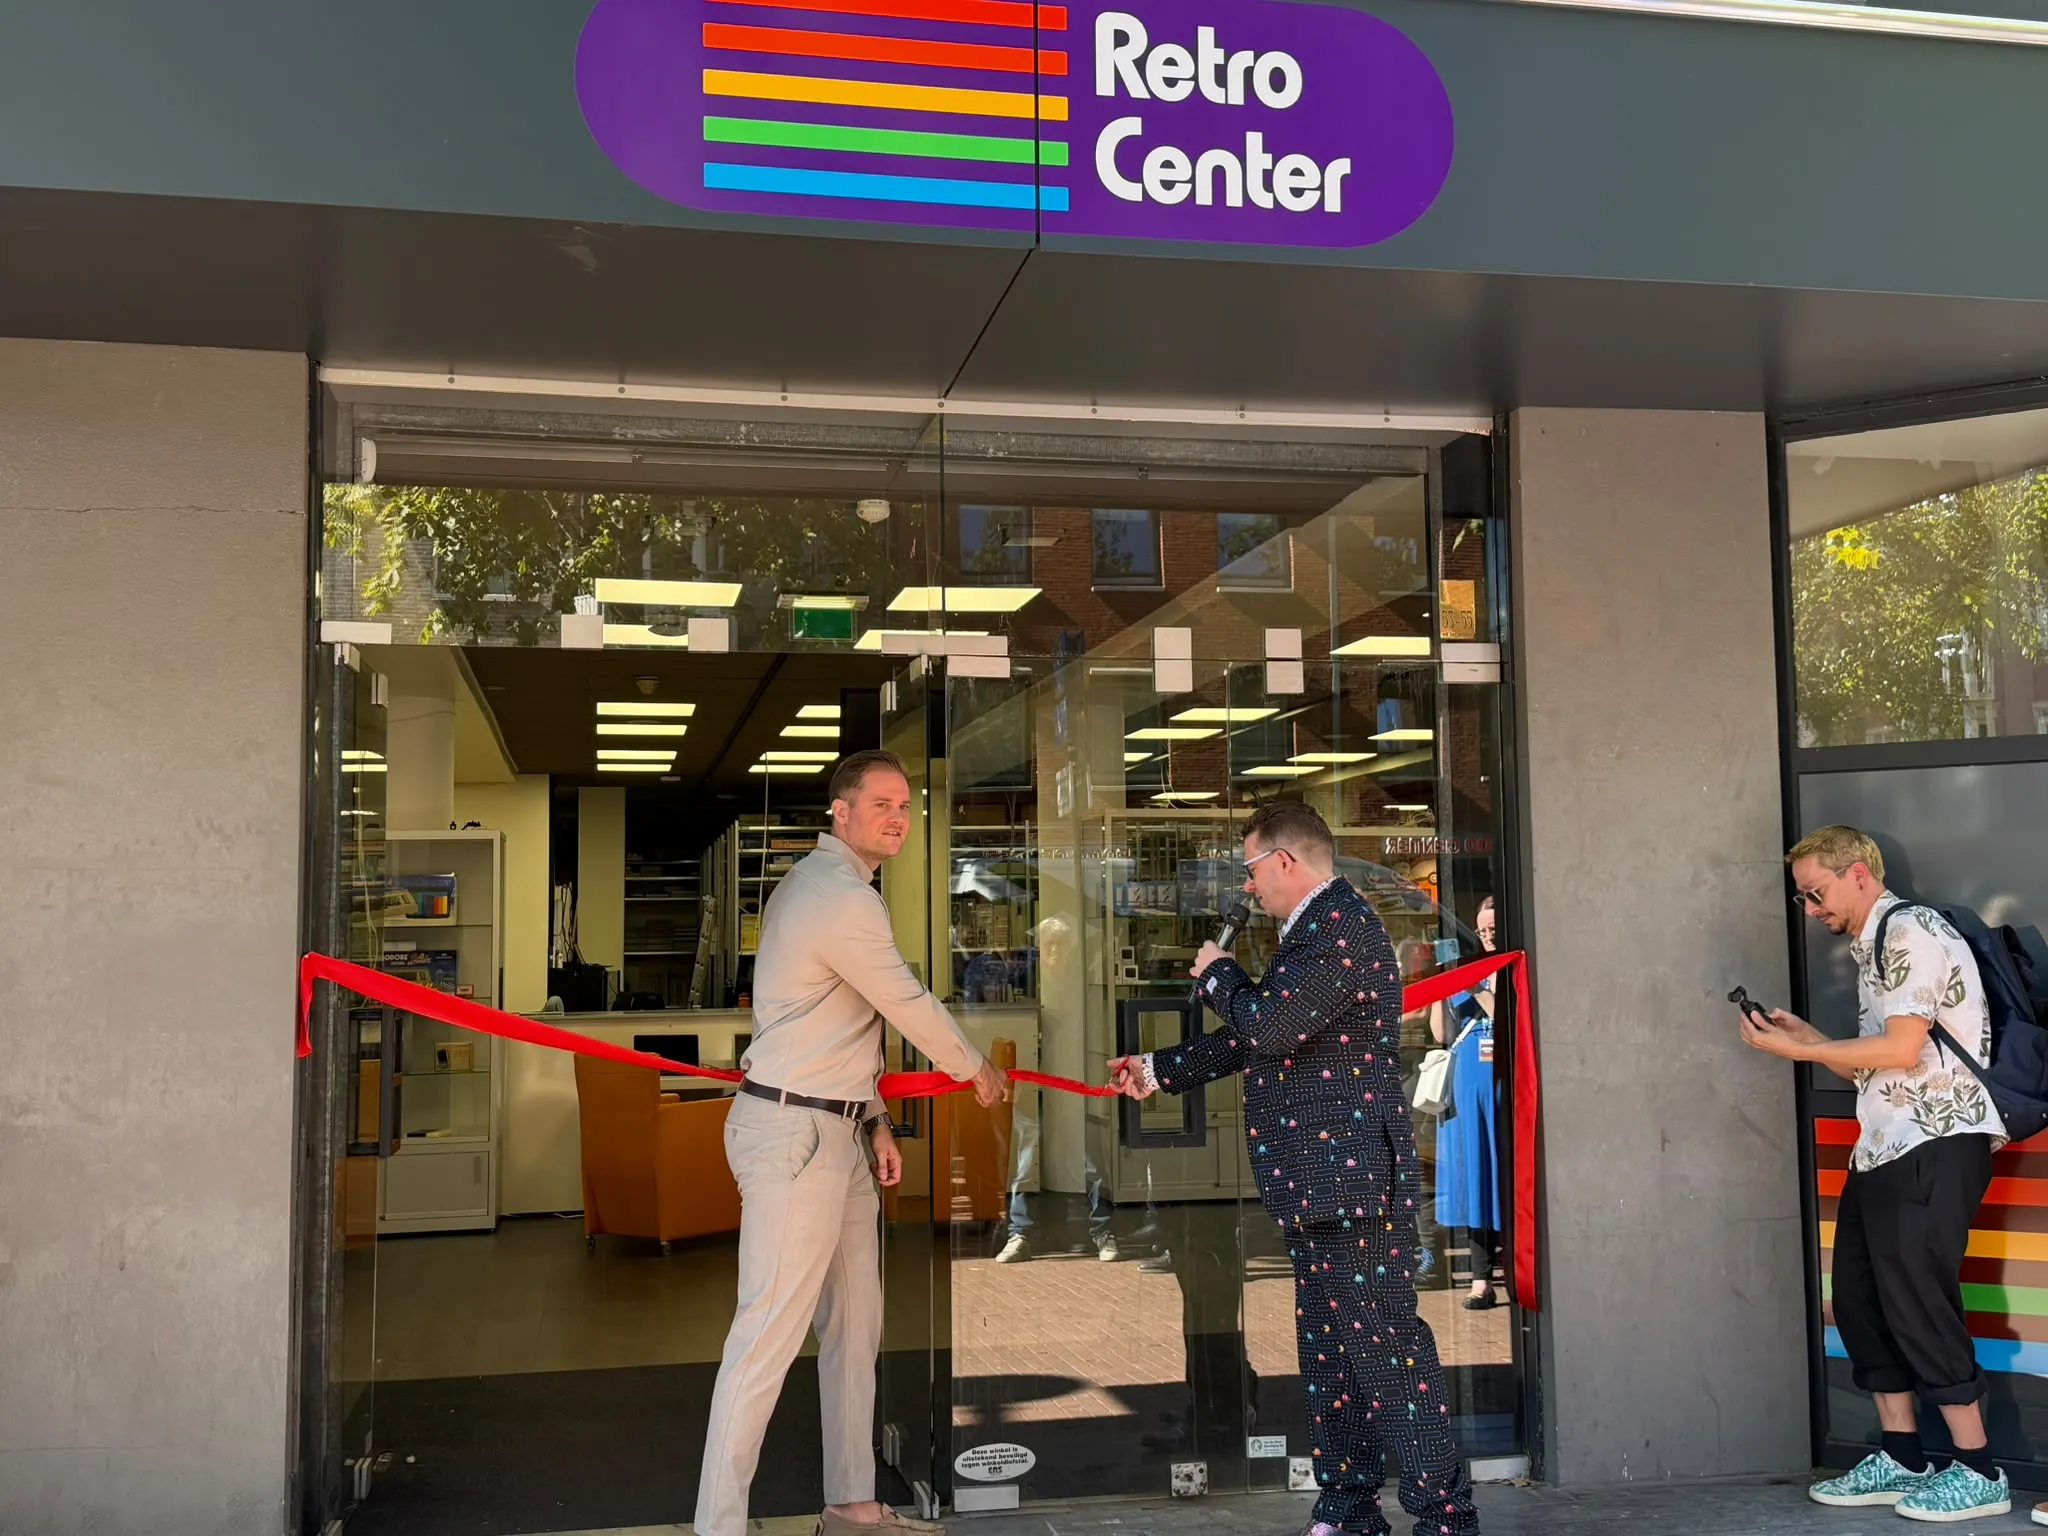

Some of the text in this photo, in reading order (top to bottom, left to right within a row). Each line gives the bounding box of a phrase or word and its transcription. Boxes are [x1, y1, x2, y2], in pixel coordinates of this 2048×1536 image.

[1095, 11, 1303, 109] Retro
[1095, 116, 1351, 213] Center
[989, 1446, 1011, 1454] winkel
[962, 1454, 997, 1462] uitstekend
[961, 1461, 980, 1469] tegen
